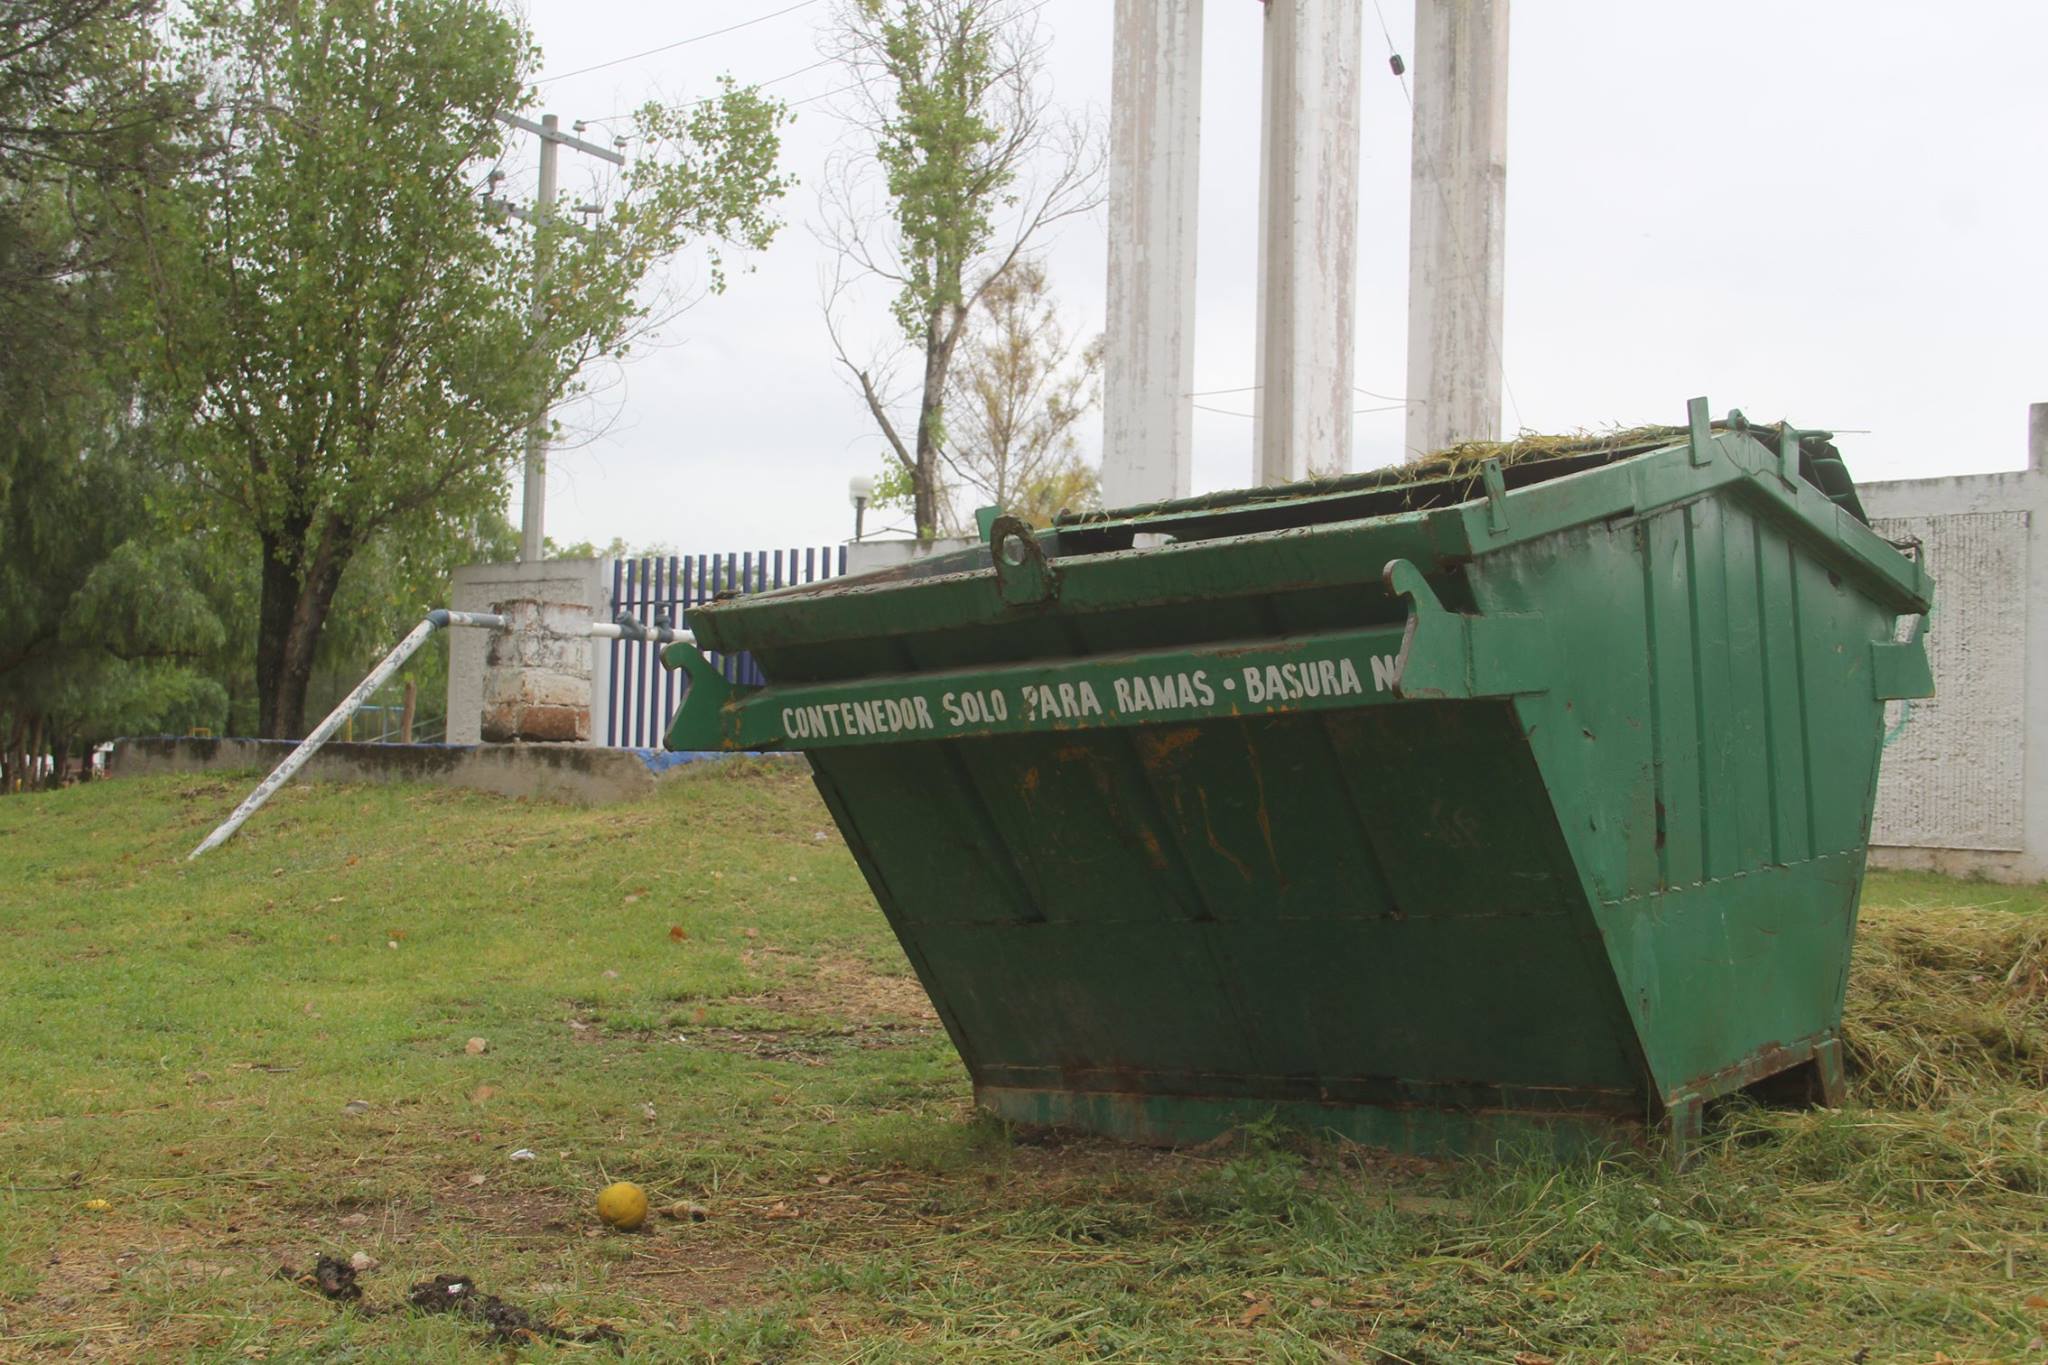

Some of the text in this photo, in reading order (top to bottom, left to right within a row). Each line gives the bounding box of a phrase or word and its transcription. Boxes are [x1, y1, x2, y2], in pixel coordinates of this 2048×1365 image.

[782, 654, 1401, 739] CONTENEDOR SOLO PARA RAMAS BASURA N
